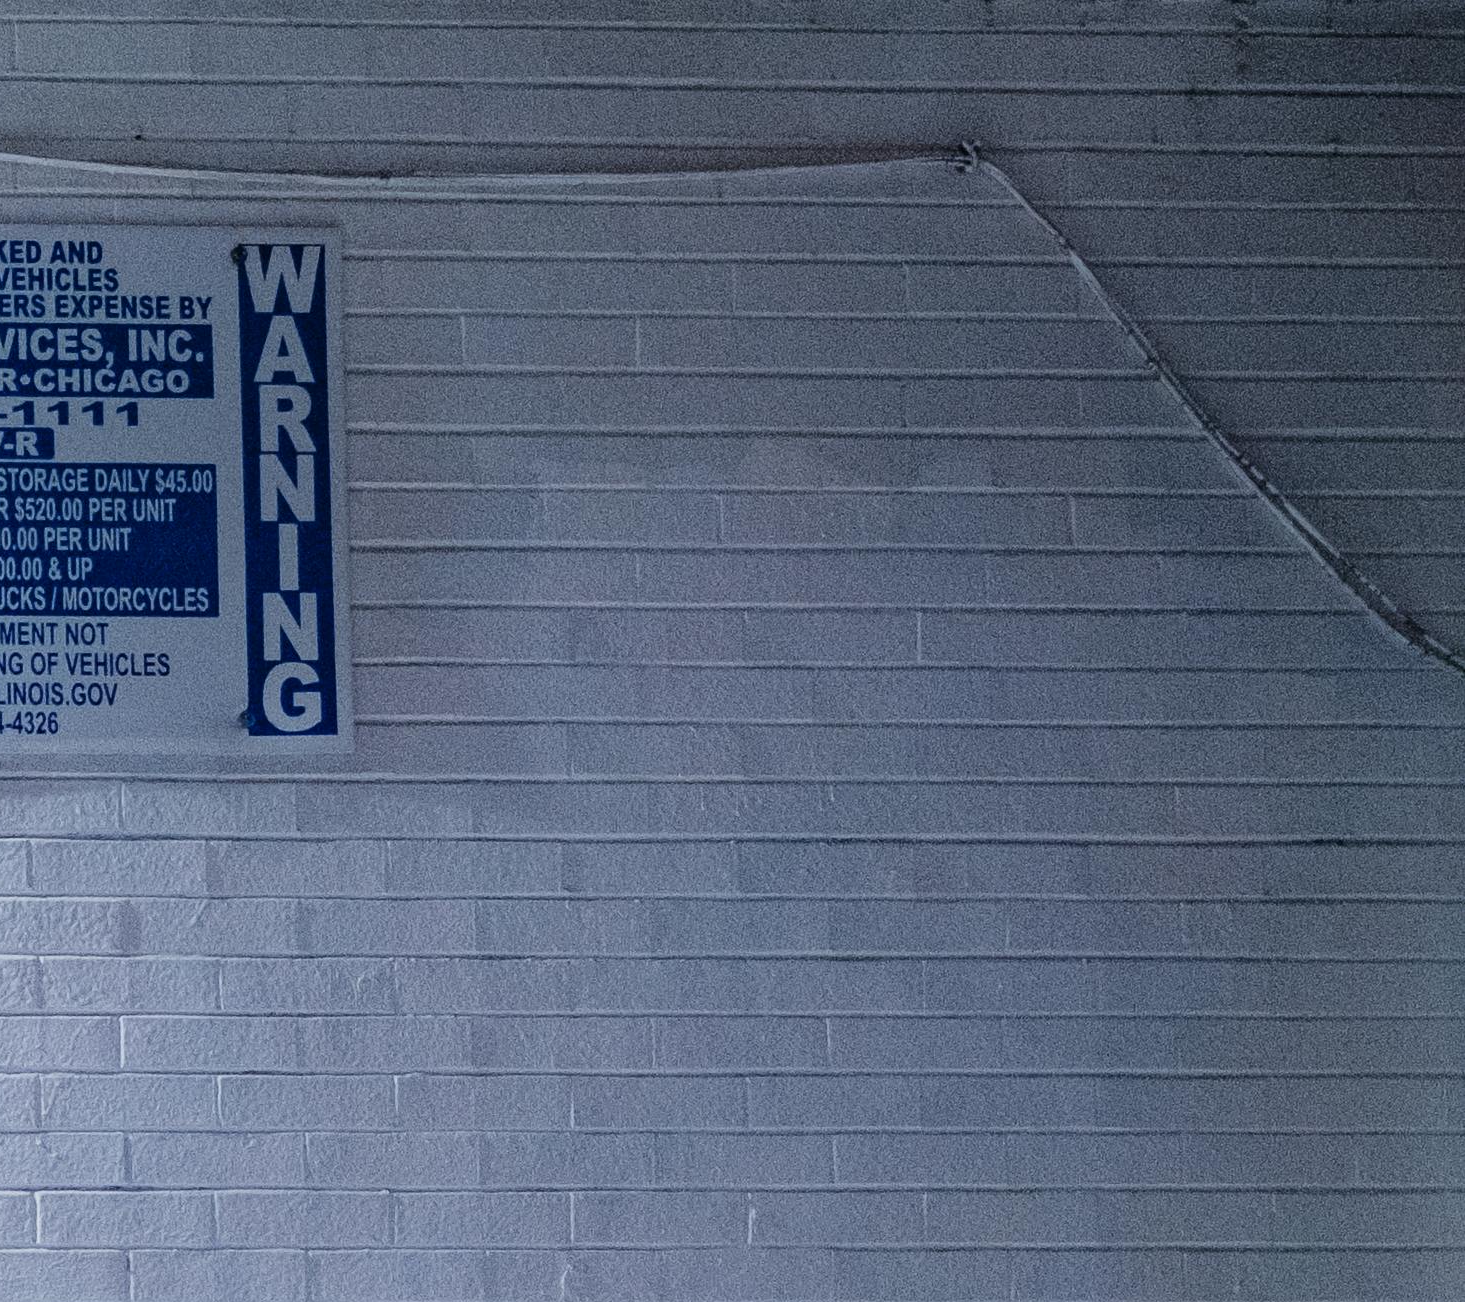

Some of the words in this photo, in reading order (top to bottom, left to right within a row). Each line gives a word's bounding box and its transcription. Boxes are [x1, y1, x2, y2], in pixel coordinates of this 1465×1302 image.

[50, 241, 103, 264] AND
[55, 295, 171, 319] EXPENSE
[180, 296, 212, 319] BY
[128, 329, 204, 362] INC.
[94, 469, 150, 492] DAILY
[155, 468, 213, 495] $45.00
[245, 246, 322, 732] WARNING
[14, 497, 82, 523] $520.00
[89, 499, 127, 521] PER
[133, 499, 176, 521] UNIT
[44, 528, 82, 550] PER
[88, 528, 131, 551] UNIT
[49, 557, 62, 580] &
[68, 557, 93, 580] UP
[51, 587, 57, 610] /
[63, 587, 209, 612] MOTORCYCLES
[65, 623, 109, 645] NOT
[31, 653, 58, 675] OF
[65, 653, 170, 677] VEHICLES
